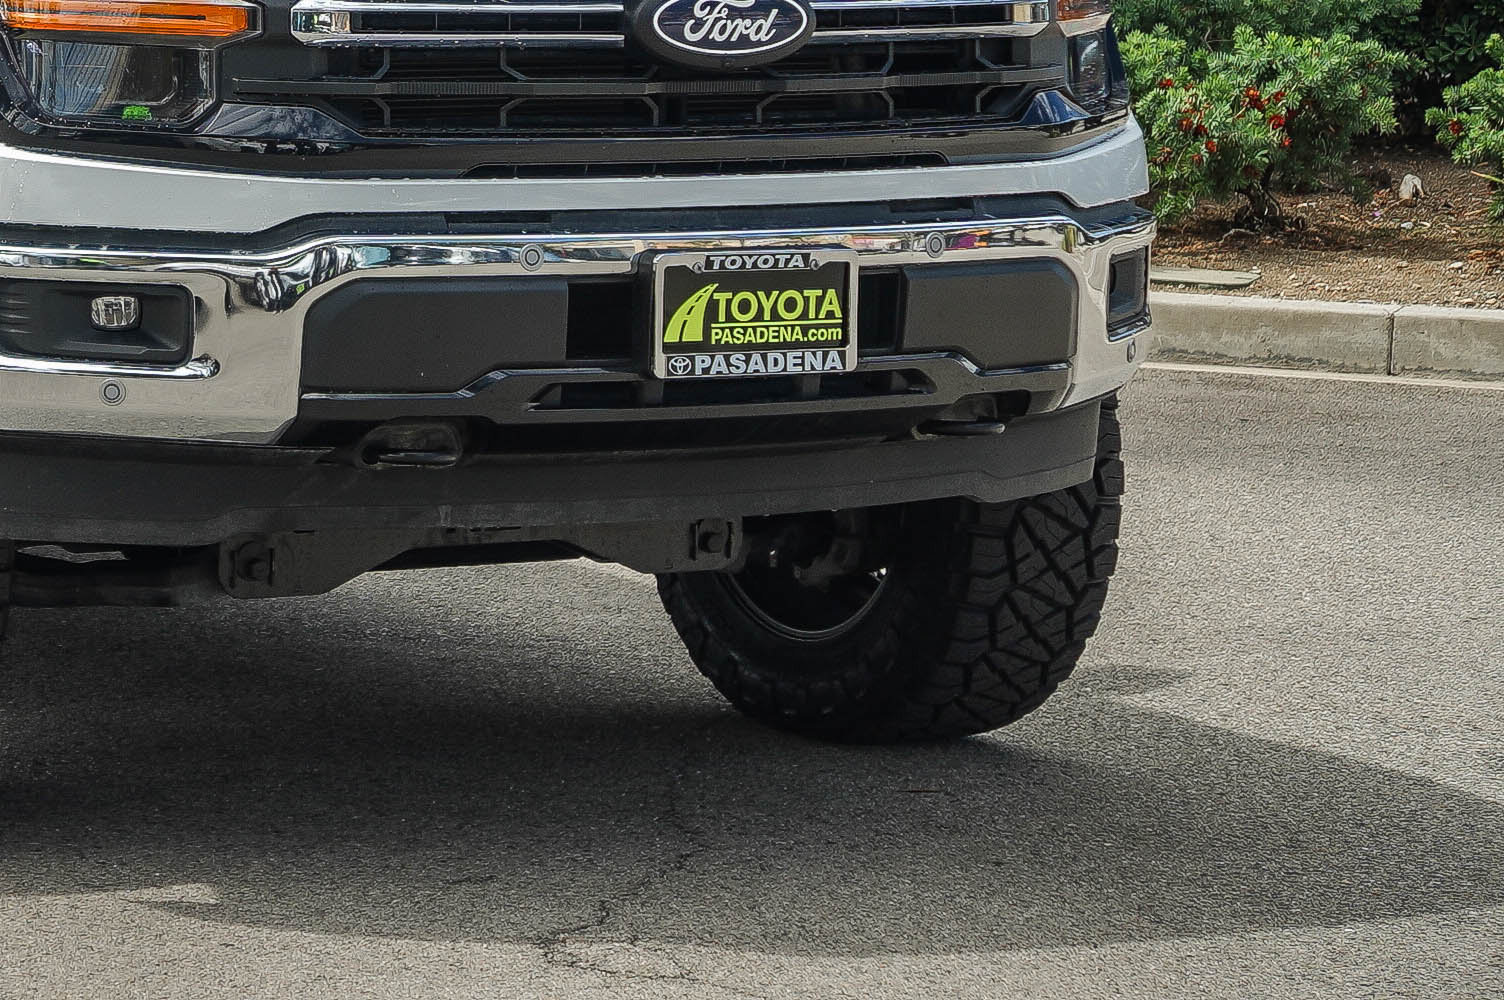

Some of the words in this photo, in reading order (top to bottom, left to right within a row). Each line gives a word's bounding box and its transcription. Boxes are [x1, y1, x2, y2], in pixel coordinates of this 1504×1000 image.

[709, 254, 806, 270] TOYOTA
[712, 288, 843, 323] TOYOTA
[711, 326, 843, 345] PASADENA.com
[695, 351, 844, 376] PASADENA
